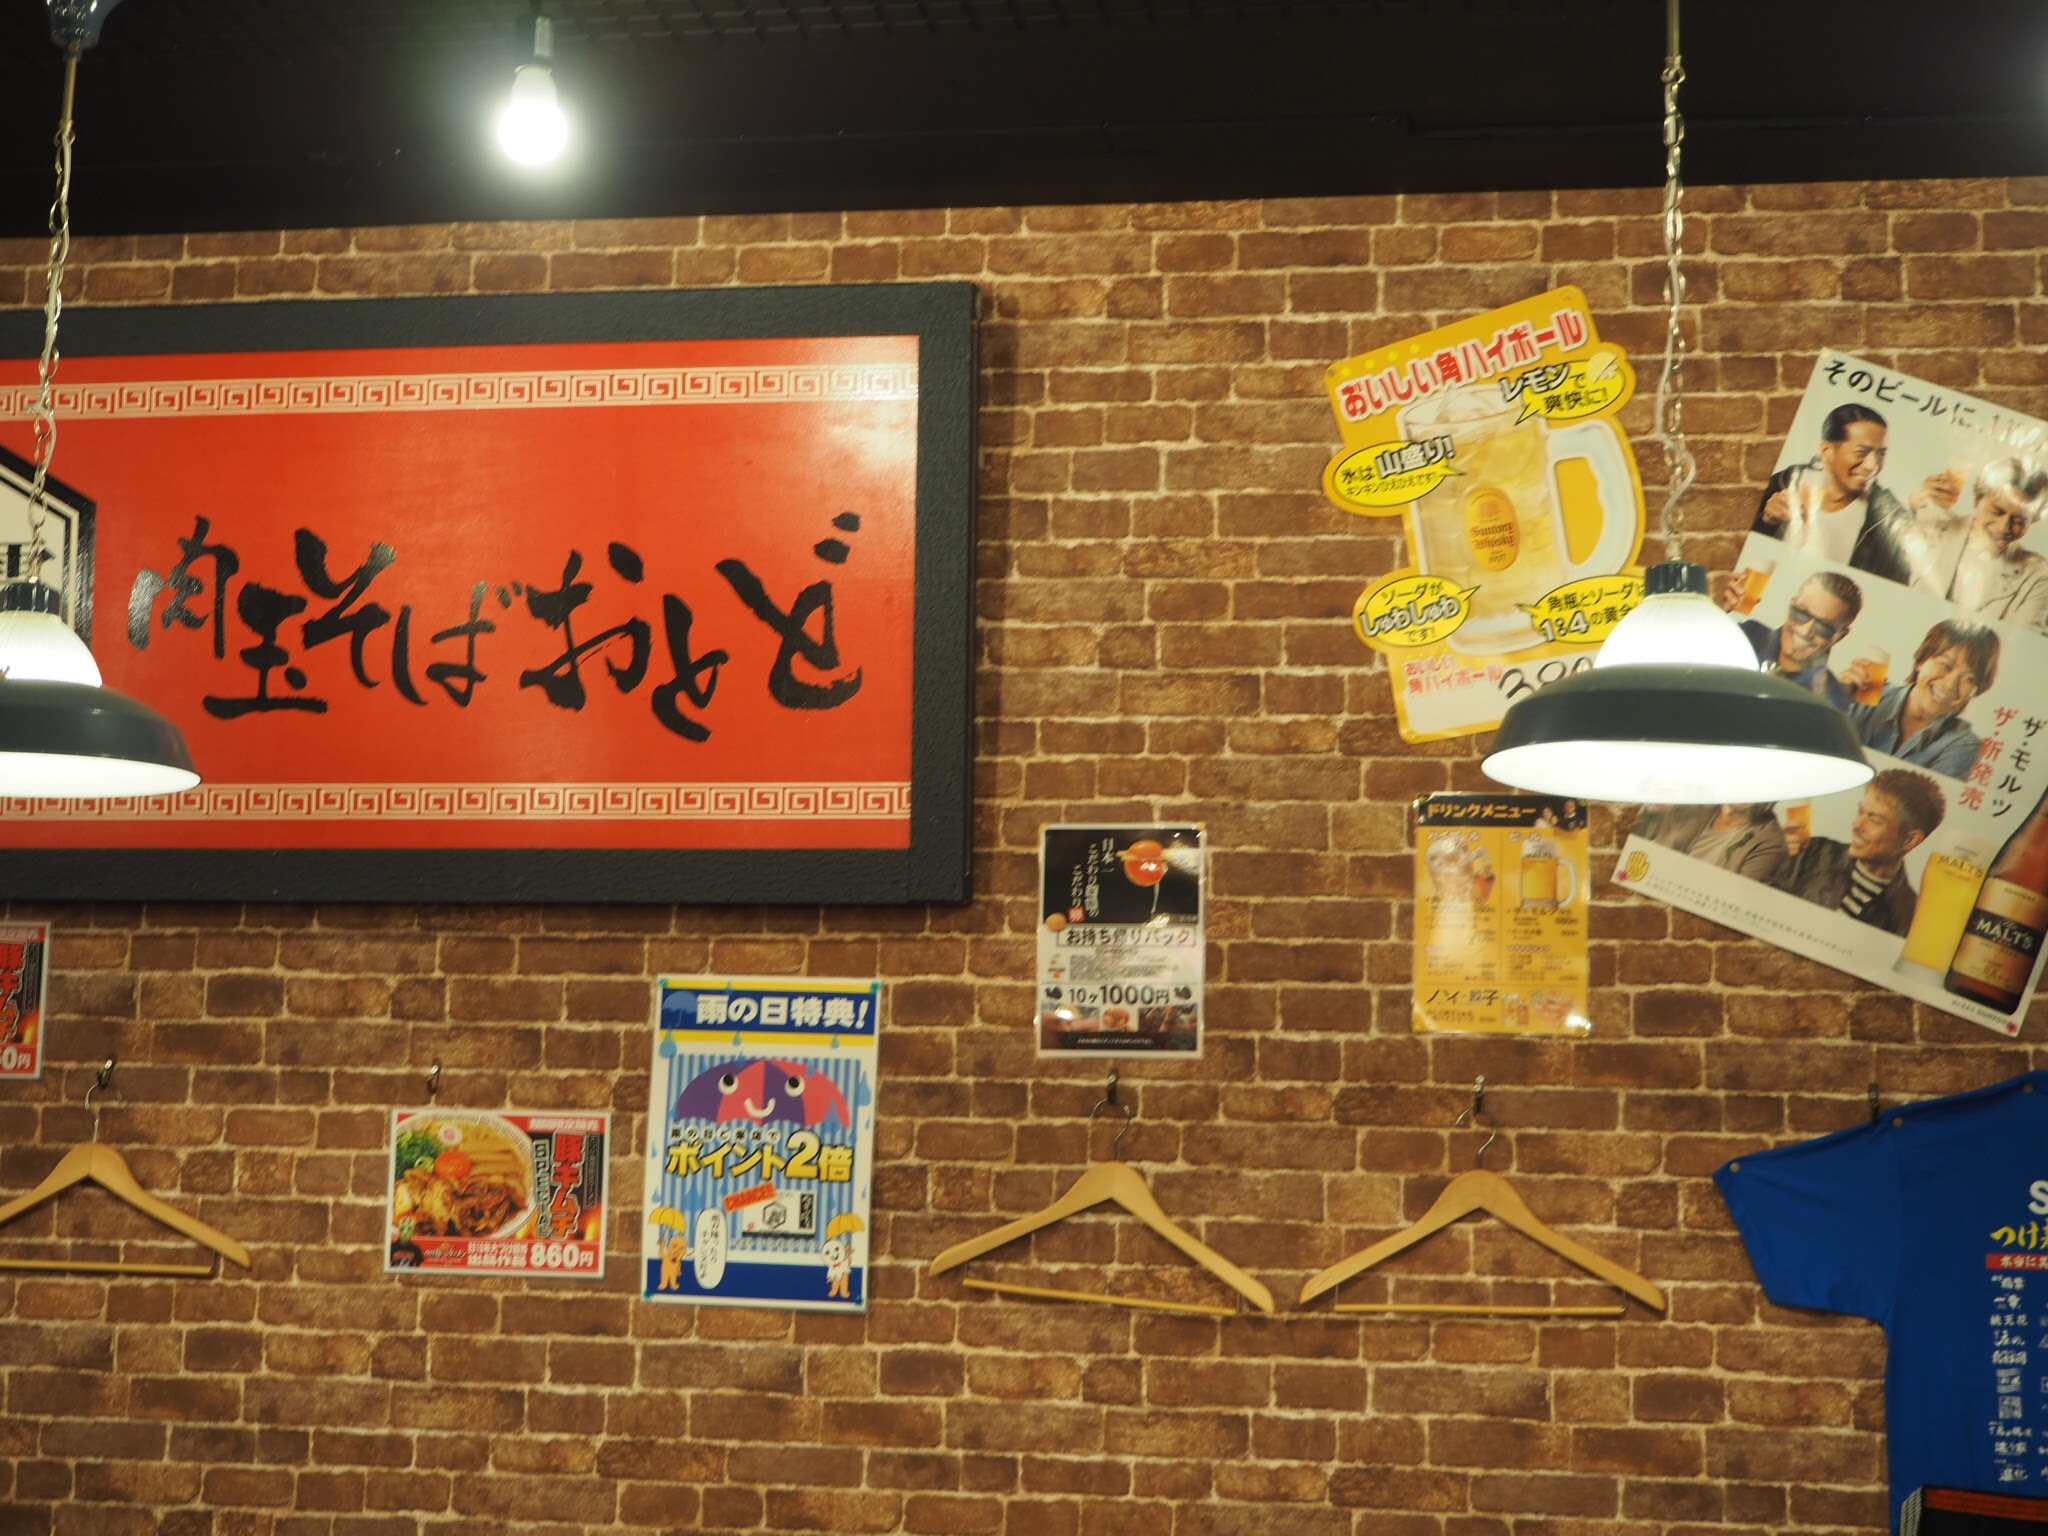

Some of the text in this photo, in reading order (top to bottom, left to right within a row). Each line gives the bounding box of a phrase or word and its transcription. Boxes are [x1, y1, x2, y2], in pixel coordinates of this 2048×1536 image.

[1339, 309, 1586, 421] おいしい角ハイボール
[1499, 363, 1586, 403] レモンで
[1381, 581, 1444, 606] ソーダが
[127, 511, 863, 743] 肉玉そばおとど
[1359, 594, 1460, 637] しゅわしゅわ
[1408, 664, 1503, 694] 角ハイボール
[1958, 705, 2019, 812] ザ・新発売
[1991, 717, 2047, 818] ザ・モルツ
[1428, 802, 1537, 819] ドリンクメニュー
[1101, 837, 1115, 873] 日本一
[1066, 927, 1190, 946] お持ち帰りパック
[1975, 918, 2034, 950] MALT'S
[696, 994, 867, 1029] 雨の日特典!
[666, 1129, 854, 1182] ポイント2倍
[550, 1131, 587, 1241] 豚キムチ
[530, 1242, 594, 1269] 860円
